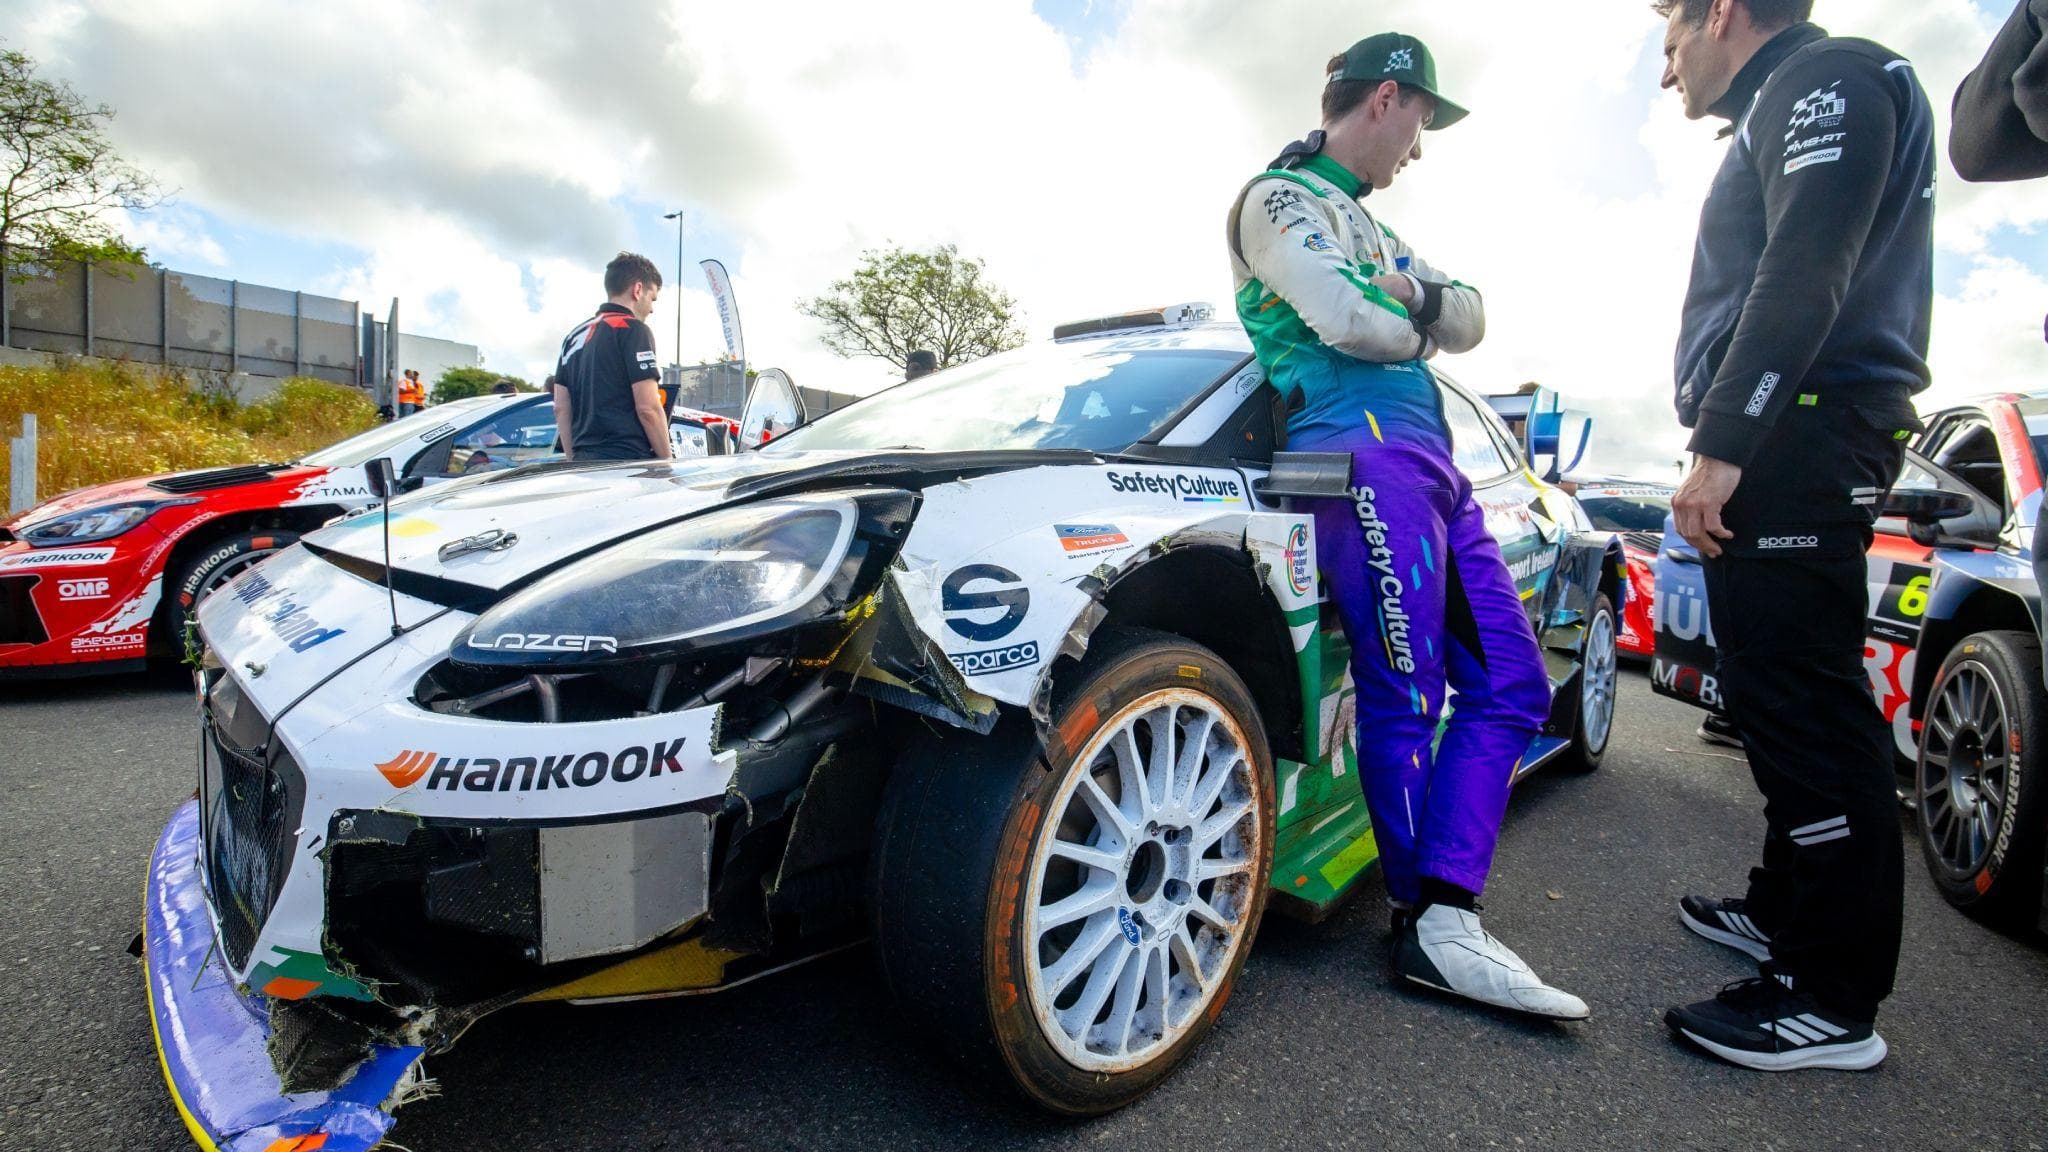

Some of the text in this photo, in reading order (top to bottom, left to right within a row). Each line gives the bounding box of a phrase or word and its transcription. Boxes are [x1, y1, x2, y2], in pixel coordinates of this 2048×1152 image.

[1749, 374, 1776, 413] sparco
[1107, 471, 1240, 500] SafetyCulture
[1074, 537, 1116, 547] TRUCKS
[1758, 535, 1818, 548] sparco
[1350, 486, 1416, 675] SafetyCulture
[1510, 554, 1531, 582] sport
[58, 581, 110, 598] OMP
[1898, 575, 1931, 617] 6
[71, 633, 144, 647] akebono
[467, 632, 619, 653] LAZER
[950, 642, 1037, 677] sparco
